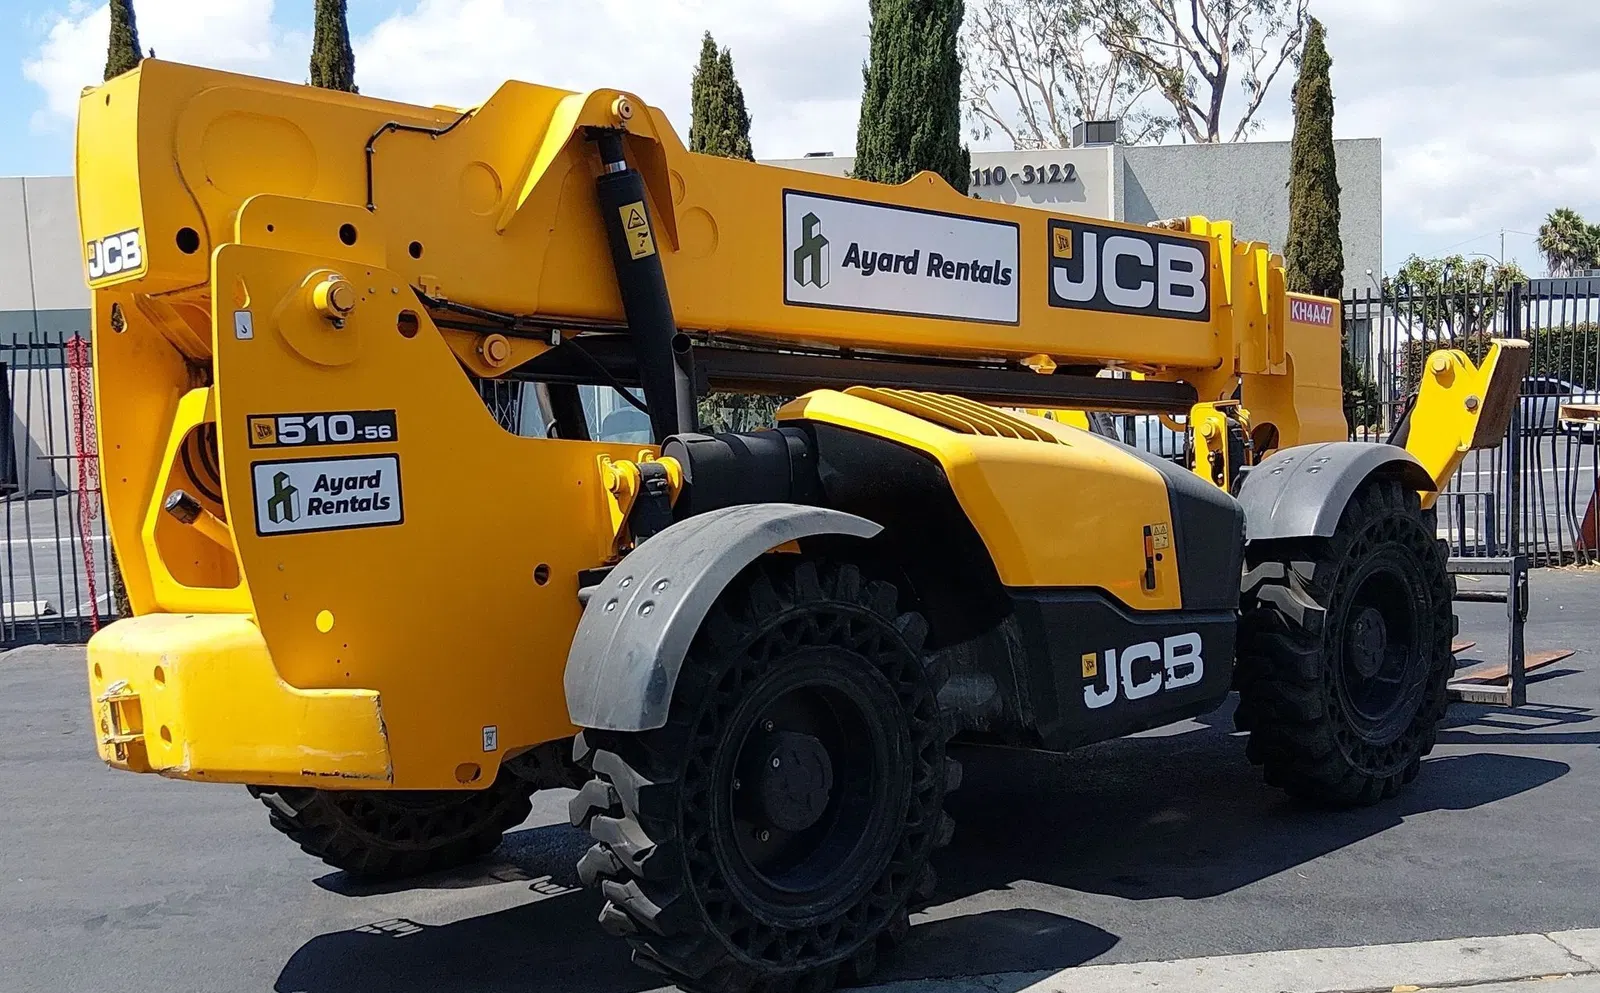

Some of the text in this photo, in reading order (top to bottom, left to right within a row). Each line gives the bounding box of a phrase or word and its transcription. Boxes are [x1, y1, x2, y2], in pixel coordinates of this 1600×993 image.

[972, 163, 1076, 187] 110-3122
[88, 231, 142, 278] JCB
[842, 242, 1012, 286] Ayard Rentals
[1053, 231, 1207, 313] JCB
[1291, 300, 1332, 325] KH4A47
[277, 414, 392, 444] 510-56
[312, 469, 382, 496] Ayard
[307, 492, 391, 516] Rentals
[1083, 632, 1204, 709] JCB
